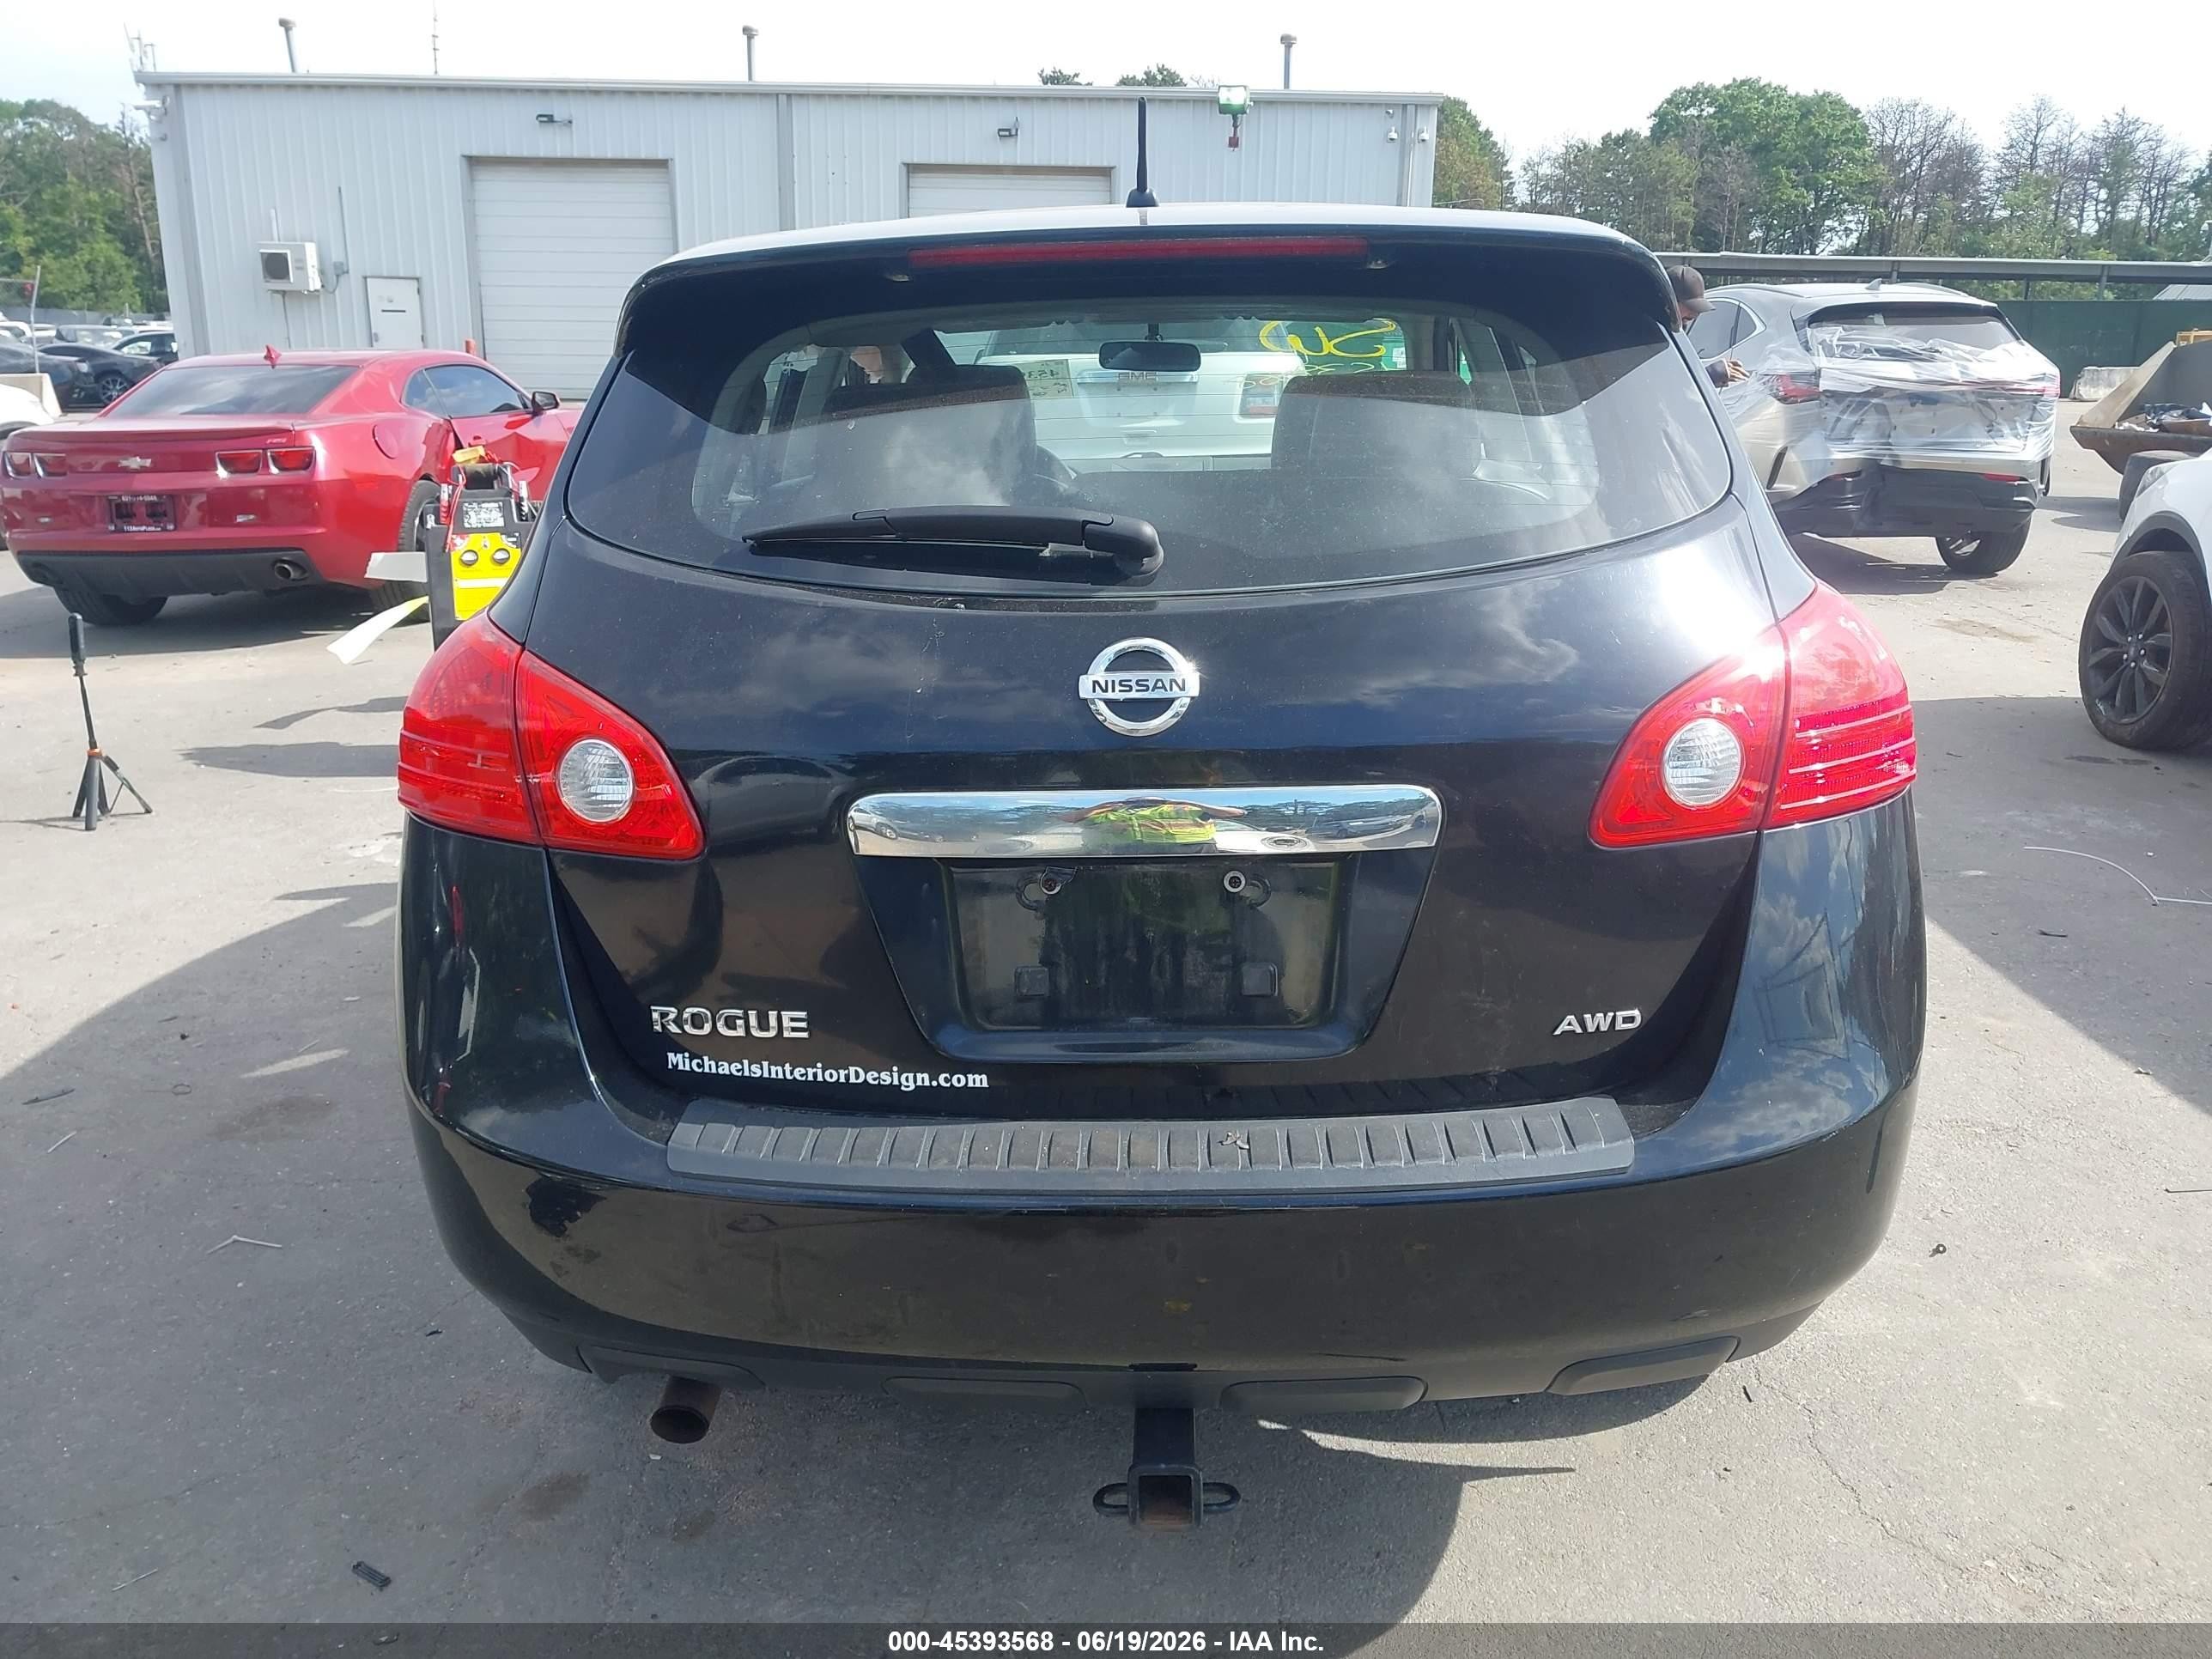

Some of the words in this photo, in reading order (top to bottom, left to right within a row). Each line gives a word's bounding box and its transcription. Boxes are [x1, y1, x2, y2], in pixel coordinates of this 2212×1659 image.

[1091, 678, 1186, 694] NISSAN
[650, 1006, 810, 1038] ROGUE
[1553, 1008, 1642, 1036] AWD
[666, 1052, 989, 1091] MichaelsInteriorDesign.com
